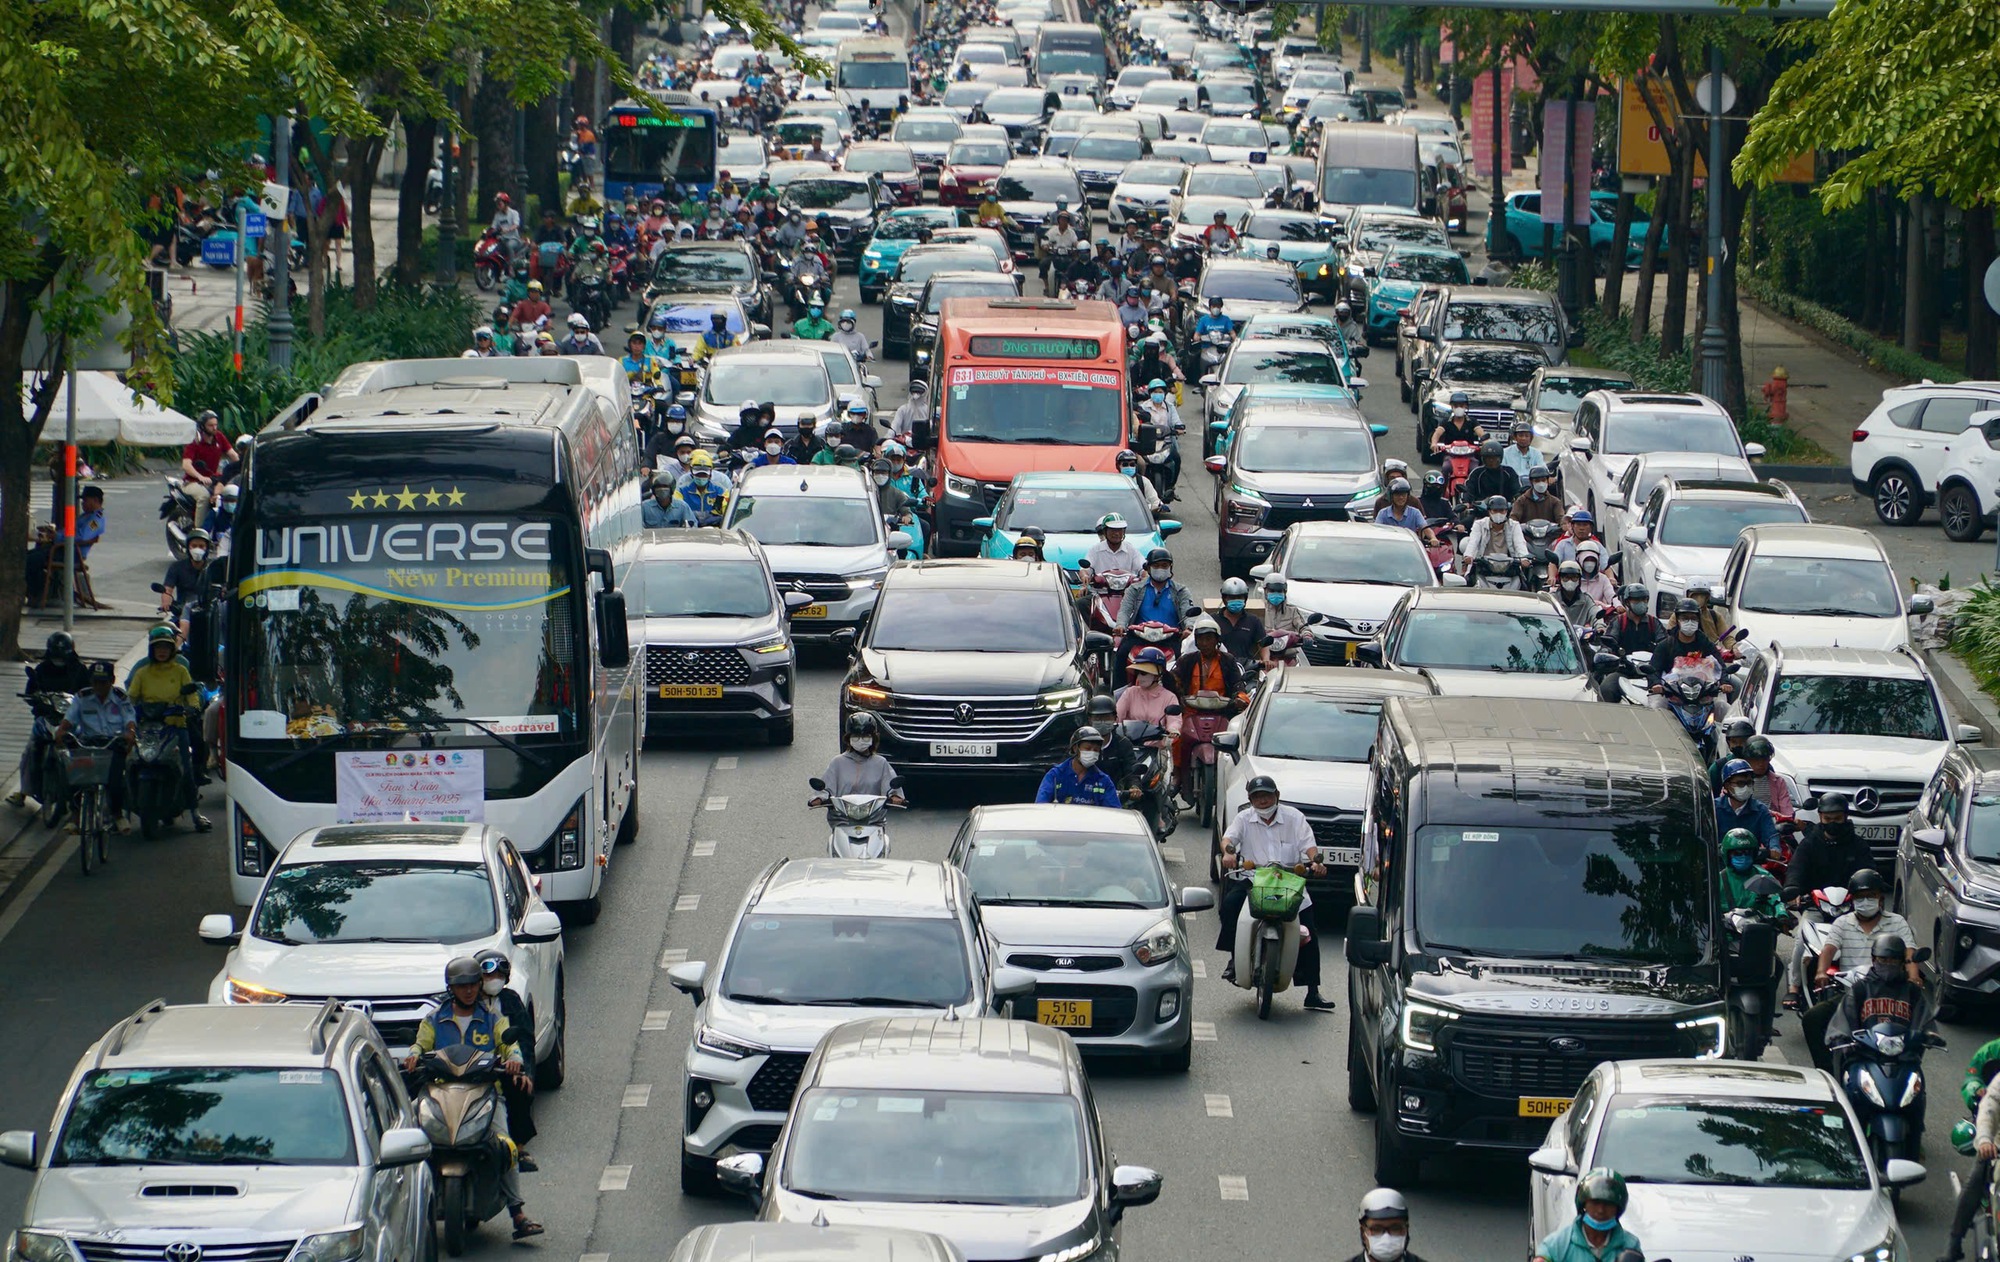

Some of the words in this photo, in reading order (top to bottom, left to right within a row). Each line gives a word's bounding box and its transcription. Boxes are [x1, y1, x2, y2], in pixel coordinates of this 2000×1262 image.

[956, 370, 973, 382] 63-1
[1090, 374, 1117, 385] GIANG
[256, 522, 552, 566] UNIVERSE
[387, 568, 438, 589] New
[445, 567, 553, 588] Premium
[665, 687, 718, 696] 50H-501.35
[490, 722, 555, 733] Sacotravel
[935, 745, 992, 755] 51L-040.18
[428, 793, 461, 806] 2025
[1854, 826, 1896, 839] -207.19
[1053, 1001, 1077, 1013] 51G
[1529, 997, 1610, 1010] SKYBUS
[1861, 998, 1912, 1021] SEMINOLES
[1043, 1014, 1086, 1026] 747.30
[472, 1029, 490, 1046] be
